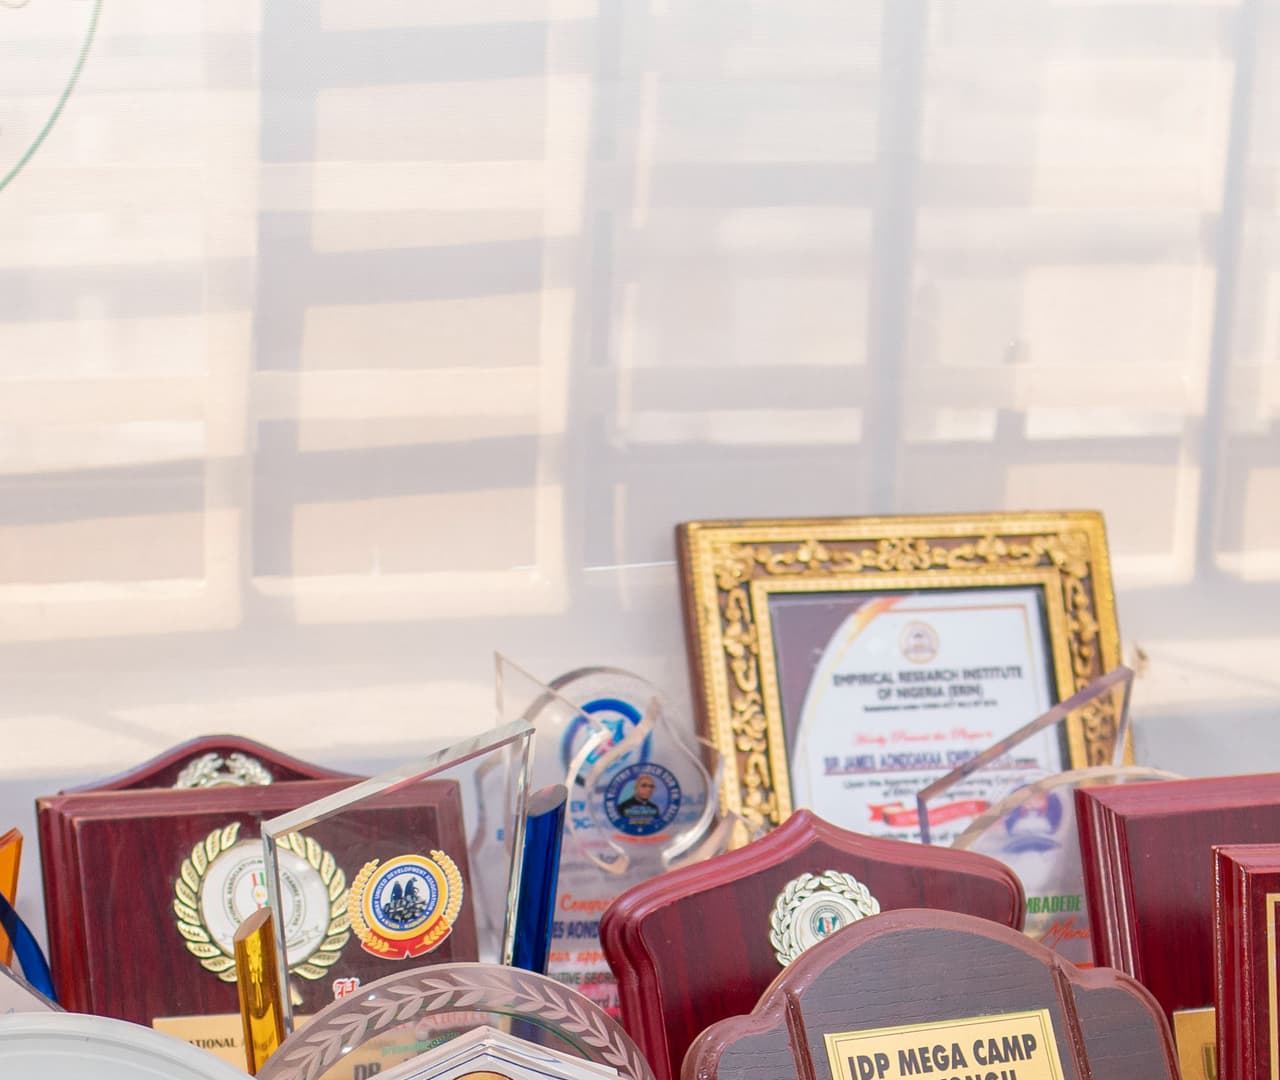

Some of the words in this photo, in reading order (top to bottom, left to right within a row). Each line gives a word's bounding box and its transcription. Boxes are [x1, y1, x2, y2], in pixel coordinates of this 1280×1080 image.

[833, 672, 894, 687] EMPIRICAL
[898, 669, 959, 683] RESEARCH
[963, 666, 1023, 680] INSTITUTE
[877, 688, 892, 700] OF
[896, 686, 944, 698] NIGERIA
[898, 1043, 968, 1077] MEGA
[972, 1033, 1037, 1066] CAMP
